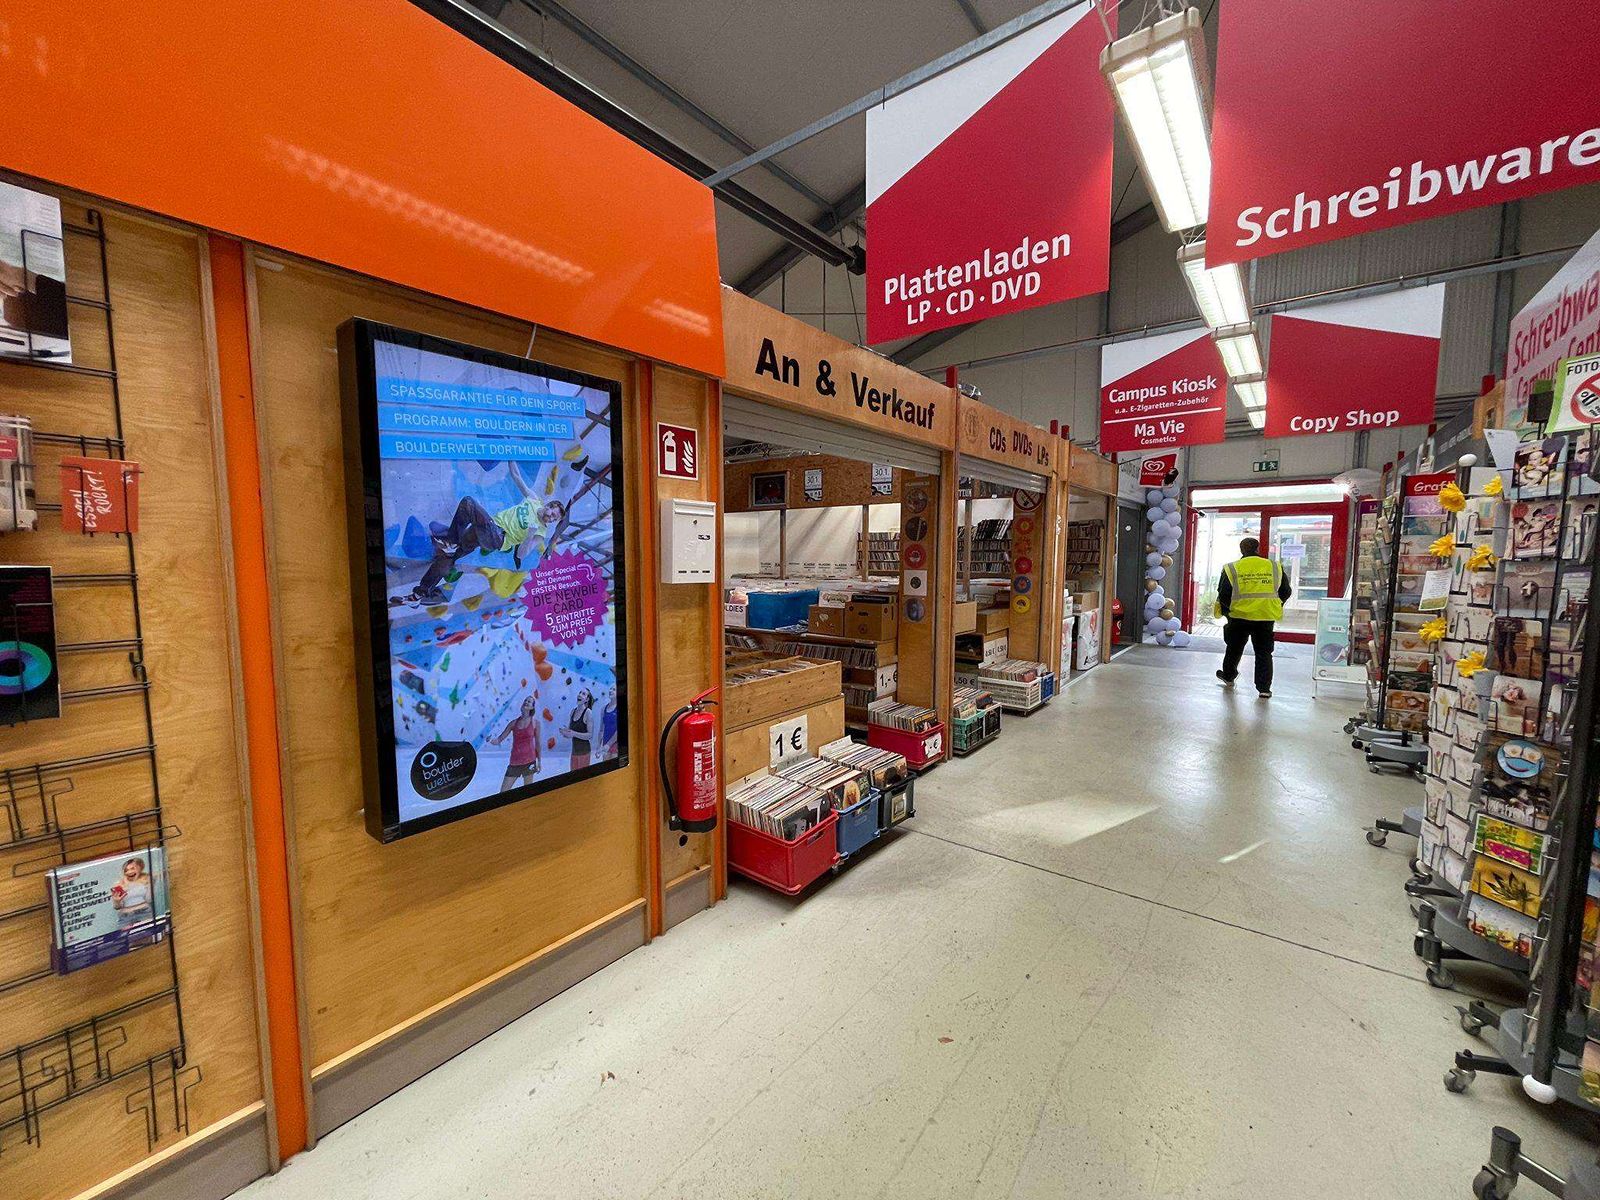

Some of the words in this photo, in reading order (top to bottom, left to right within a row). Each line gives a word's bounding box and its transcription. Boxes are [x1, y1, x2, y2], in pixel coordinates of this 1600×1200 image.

[1236, 127, 1600, 246] Schreibware
[884, 233, 1071, 305] Plattenladen
[907, 300, 931, 325] LP
[946, 289, 975, 315] CD
[991, 271, 1041, 304] DVD
[755, 337, 800, 387] An
[815, 359, 837, 398] &
[850, 371, 936, 430] Verkauf
[1109, 385, 1167, 403] Campus
[1172, 375, 1217, 395] Kiosk
[390, 384, 493, 405] SPASSGARANTIE
[521, 397, 544, 409] DEIN
[546, 400, 581, 413] SPORT-
[394, 413, 472, 428] PROGRAMM:
[475, 418, 533, 433] BOULDERN
[535, 422, 546, 433] IN
[548, 423, 567, 434] DER
[1134, 424, 1155, 437] Ma
[1160, 420, 1185, 435] Vie
[1290, 416, 1339, 433] Copy
[1346, 409, 1400, 427] Shop
[395, 441, 487, 455] BOULDERWELT
[490, 444, 549, 457] DORTMUND
[989, 426, 1006, 453] CDs
[1012, 430, 1032, 456] DVDs
[1036, 444, 1049, 466] LPs
[1140, 435, 1177, 445] Cosmetics
[535, 568, 554, 578] Unser
[555, 565, 576, 576] Special
[531, 585, 557, 595] ERSTEN
[533, 592, 552, 607] DIE
[555, 584, 598, 602] NEWBIE
[545, 613, 554, 626] 5
[555, 607, 596, 624] EINTRITTE
[553, 598, 584, 614] CARD
[551, 623, 568, 634] ZUM
[570, 616, 593, 629] PREIS
[560, 629, 577, 640] VON
[775, 733, 783, 757] 1
[791, 727, 802, 751] €
[422, 756, 464, 780] boulder
[426, 772, 453, 791] welt
